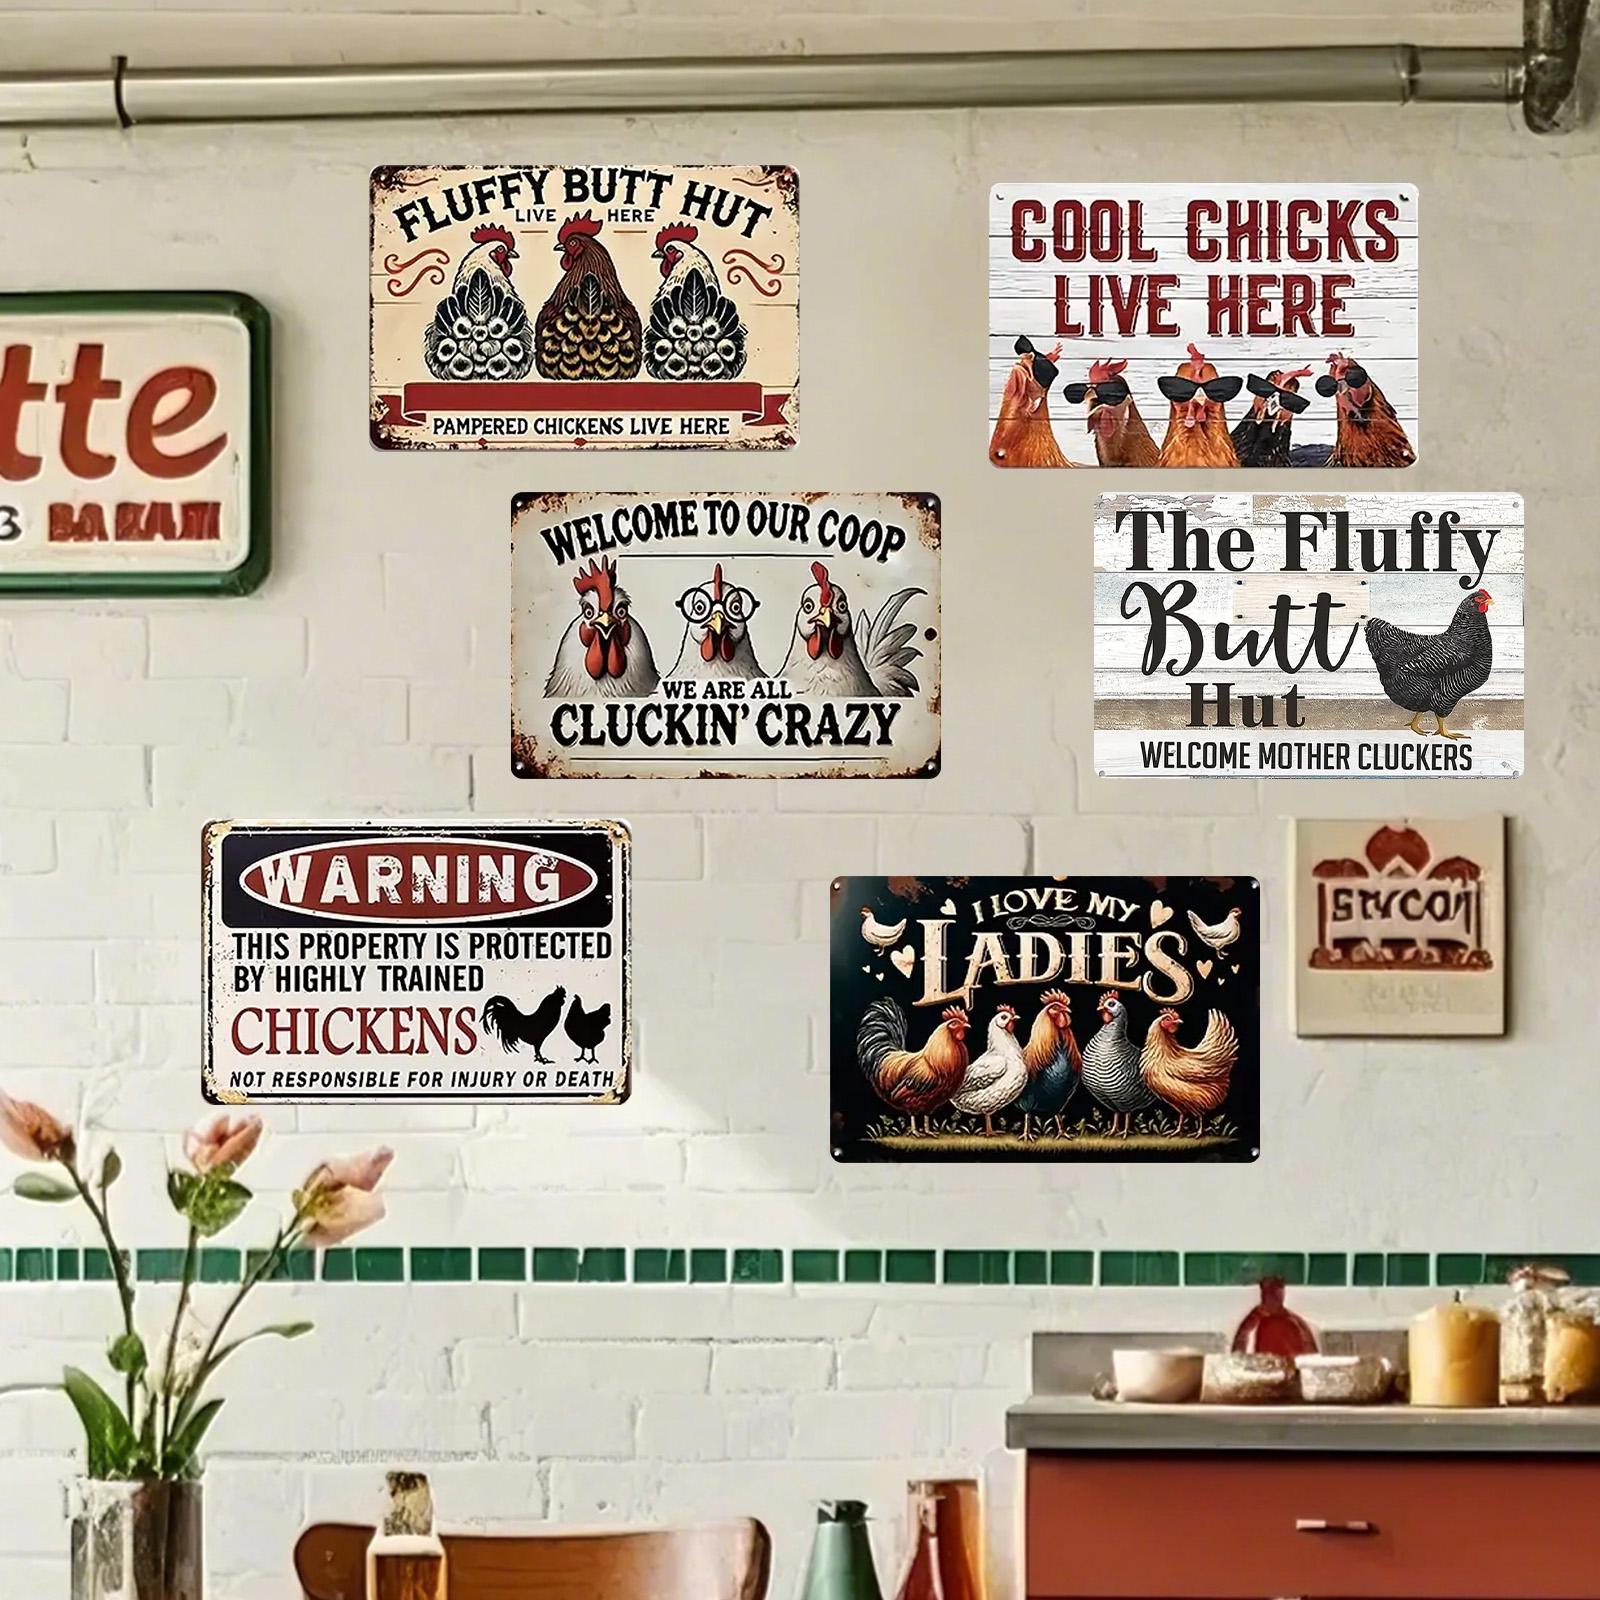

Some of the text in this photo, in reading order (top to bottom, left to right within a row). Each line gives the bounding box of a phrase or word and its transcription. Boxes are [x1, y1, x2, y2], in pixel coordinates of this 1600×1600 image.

[393, 167, 773, 242] FLUFFY BUTT HUT
[515, 209, 655, 223] LIVE HERE
[1010, 199, 1400, 262] COOL CHICKS
[1054, 274, 1356, 338] LIVE HERE
[433, 417, 730, 436] PAMPERED CHICKENS LIVE HERE
[541, 500, 906, 566] WELCOME TO OUR COOP
[1115, 510, 1500, 590] The Fluffy
[1120, 580, 1360, 677] Butt
[663, 680, 792, 700] WE ARE ALL
[1185, 683, 1306, 728] Hut
[550, 703, 901, 747] CLUCKIN' CRAZY
[1140, 741, 1472, 770] WELCOME MOTHER CLUCKERS
[258, 854, 560, 904] WARNING
[972, 888, 1140, 924] I LOVE MY
[232, 931, 611, 960] THIS PROPERTY IS PROTECTED
[912, 916, 1195, 1010] LADIES
[234, 965, 484, 992] BY HIGHLY TRAINED
[231, 1006, 478, 1056] CHICKENS
[229, 1071, 614, 1087] NOT RESPONSIBLE FOR INJURY OR DEATH
